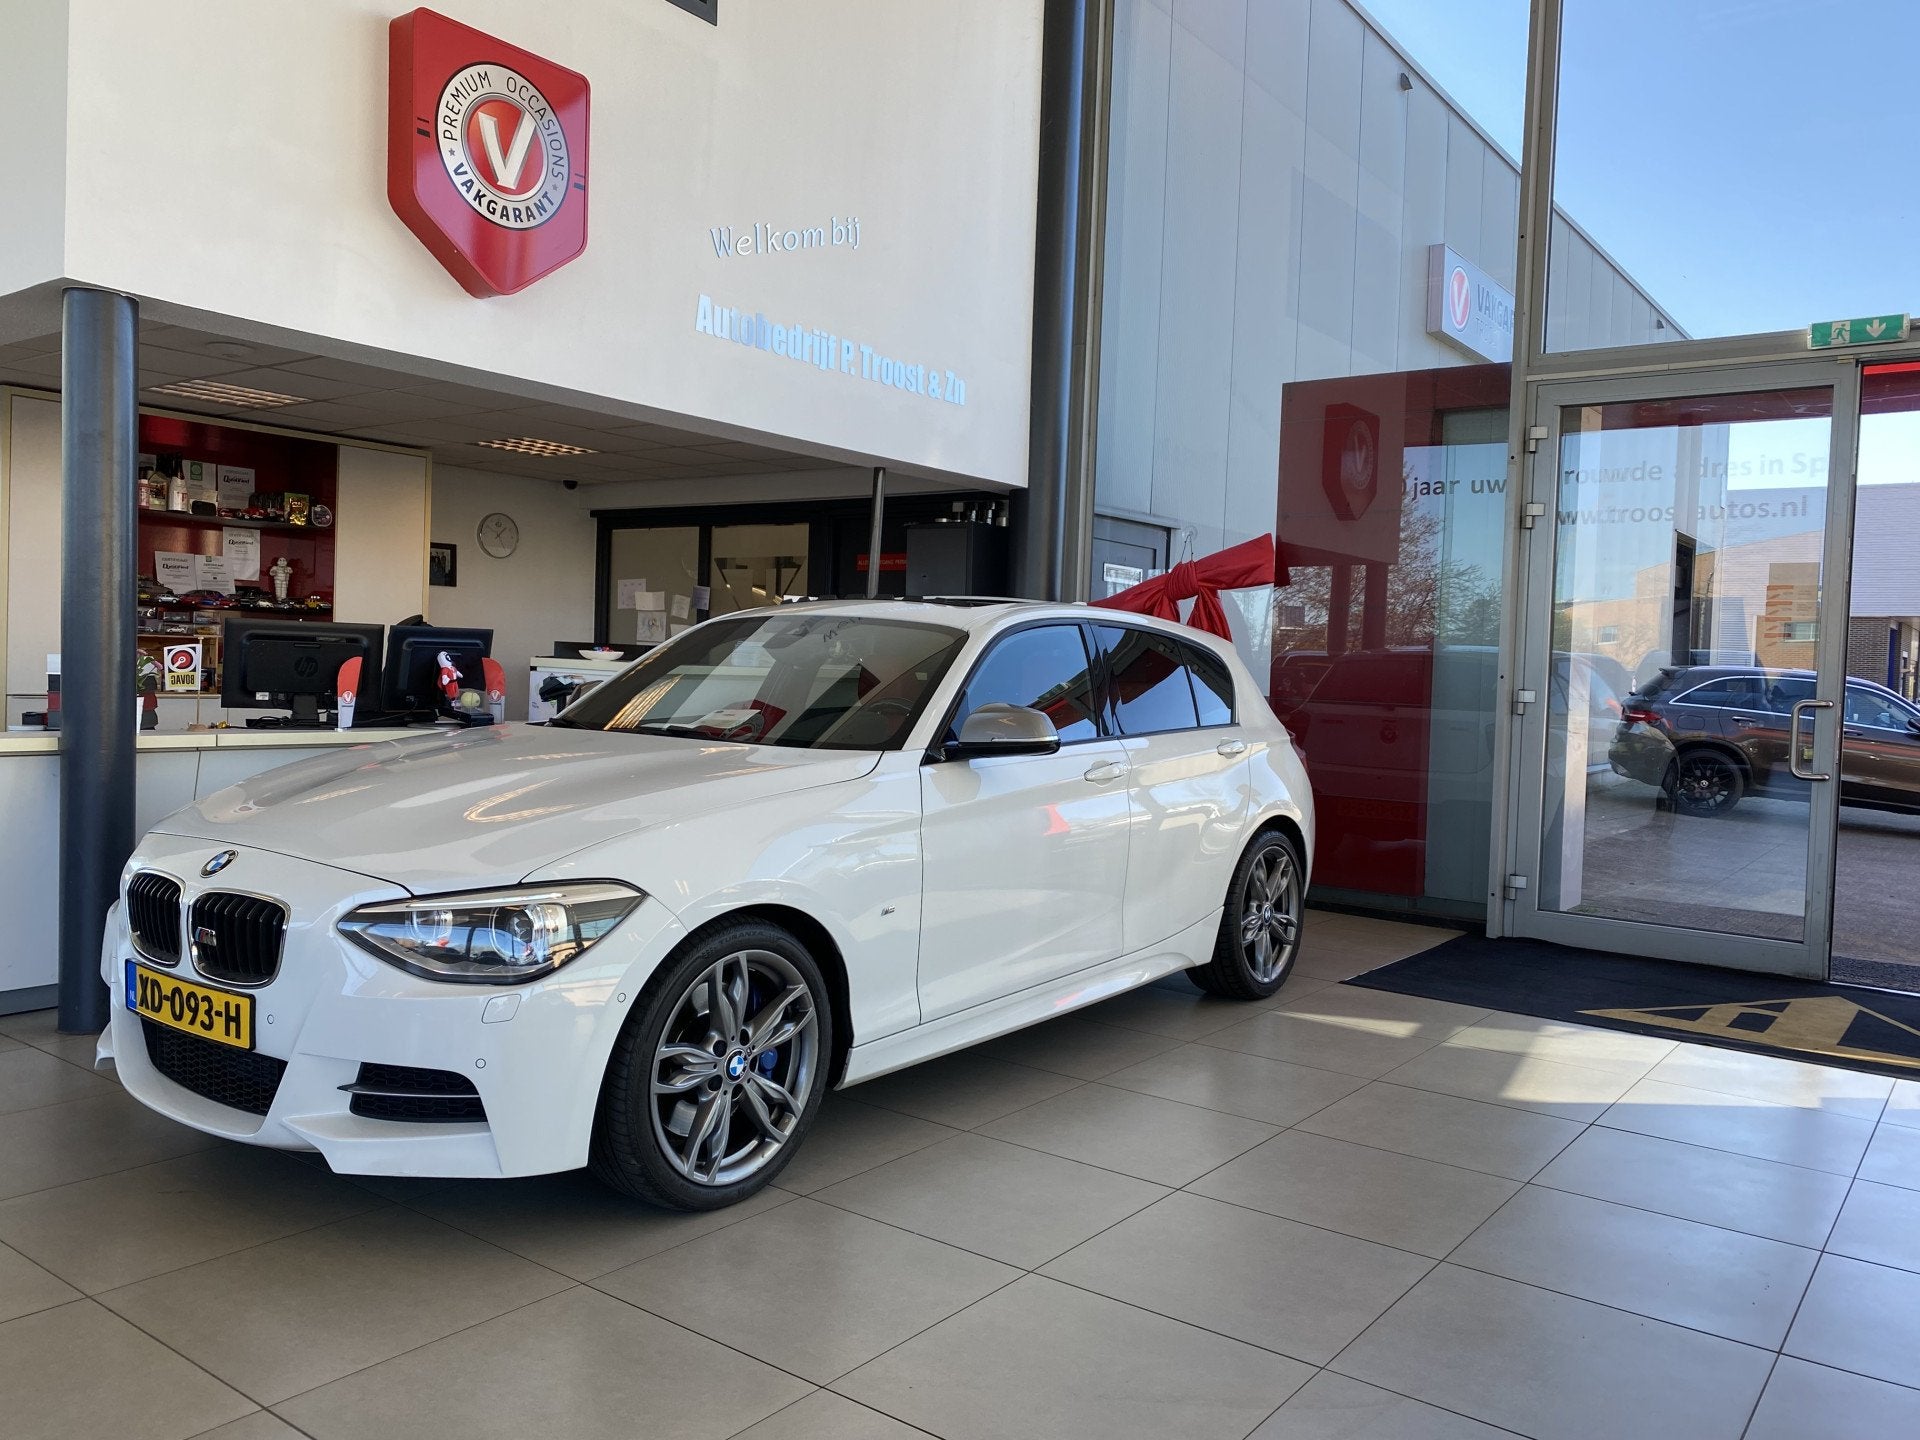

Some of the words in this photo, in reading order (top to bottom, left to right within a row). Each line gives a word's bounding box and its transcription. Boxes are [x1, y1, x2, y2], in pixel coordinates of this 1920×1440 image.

[443, 70, 492, 143] PREMIUM
[506, 75, 564, 183] OCCASIONS
[477, 109, 538, 190] V
[453, 162, 556, 224] VAKGARANT
[710, 223, 826, 259] Welkom
[830, 216, 862, 250] bij
[695, 293, 838, 371] Autobedrijf
[840, 337, 856, 376] P.
[859, 344, 925, 395] Troost
[927, 372, 941, 400] &
[944, 369, 966, 406] Zn
[1411, 476, 1461, 502] jaar
[1470, 478, 1508, 495] uw
[1564, 460, 1664, 485] rouwde
[1675, 454, 1753, 478] dres
[1759, 453, 1784, 476] in
[1790, 451, 1828, 479] Sp
[137, 973, 242, 1040] XD-093-H
